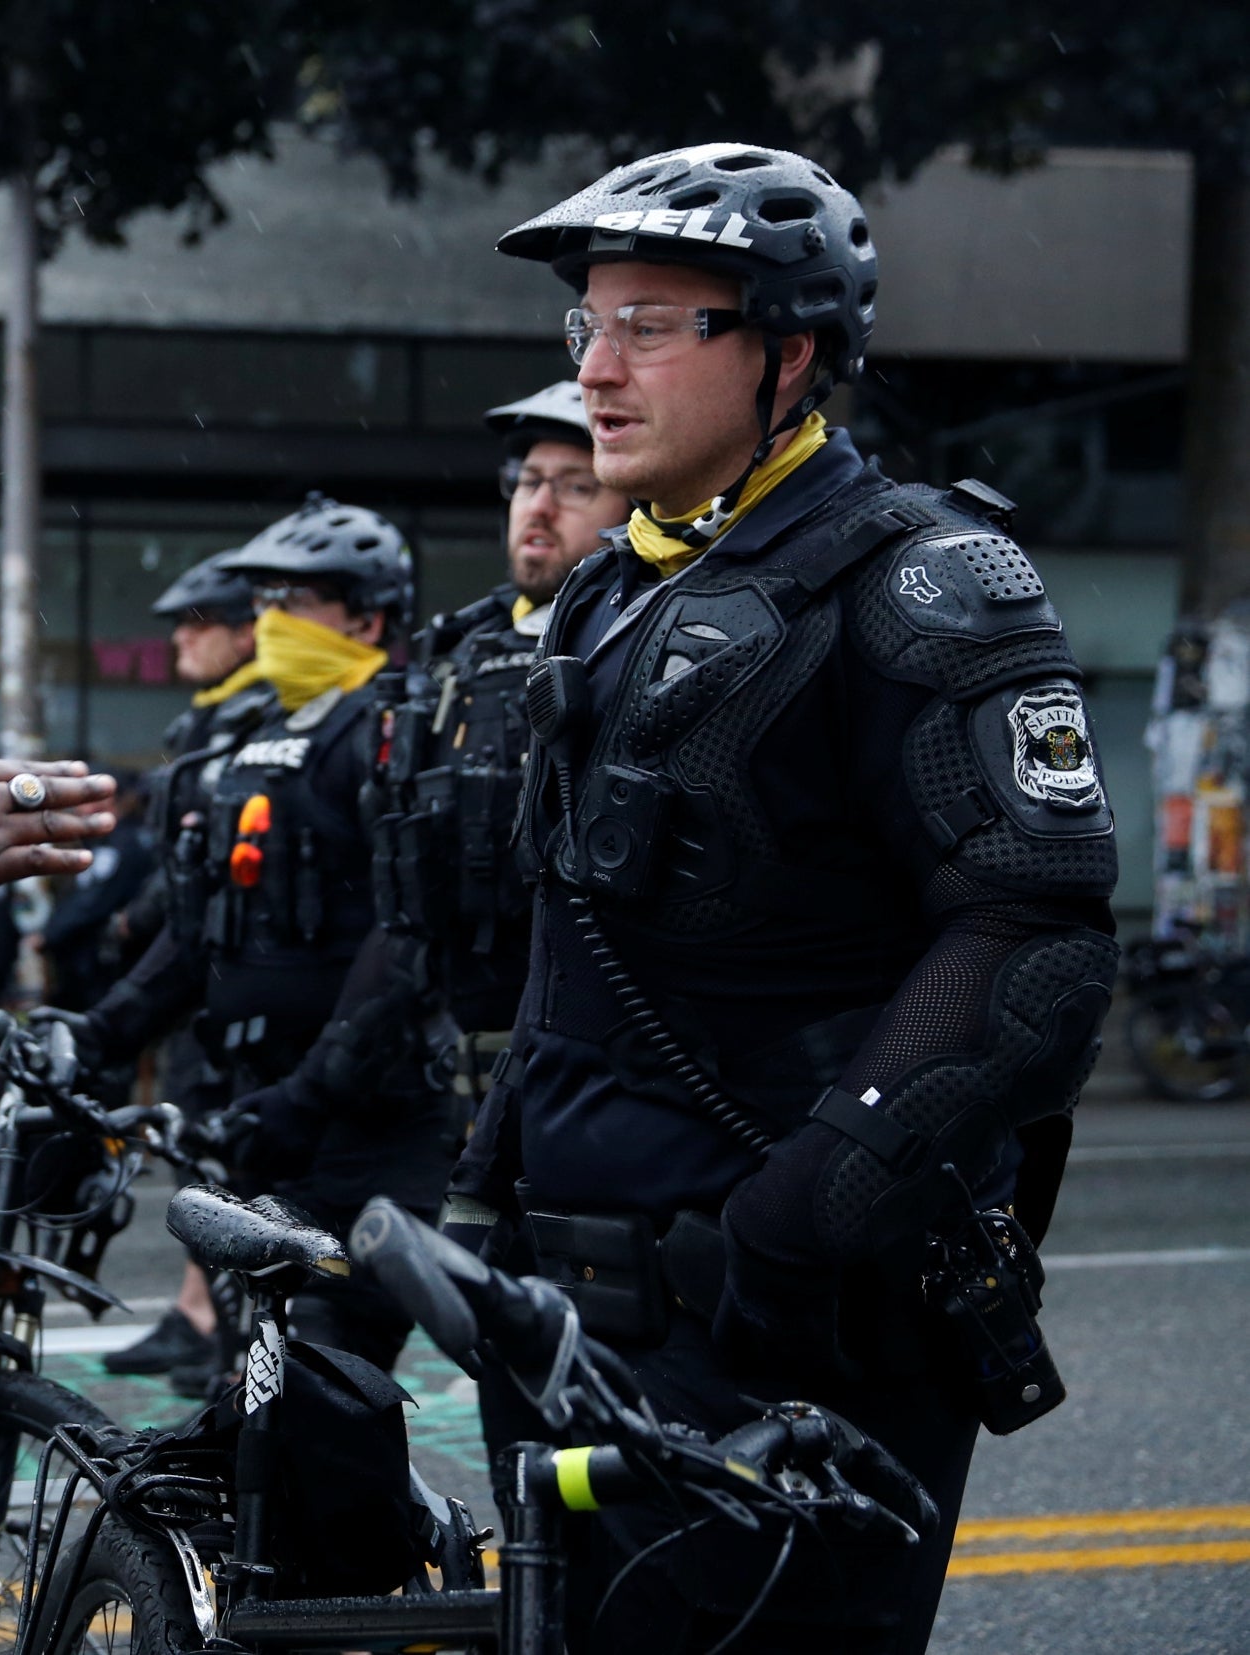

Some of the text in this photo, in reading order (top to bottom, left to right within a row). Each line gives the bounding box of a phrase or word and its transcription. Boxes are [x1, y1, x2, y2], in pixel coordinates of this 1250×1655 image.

[594, 208, 754, 249] BELL
[1028, 710, 1086, 732] SEATTLE
[1041, 771, 1090, 785] POLIC
[592, 870, 611, 883] AXON
